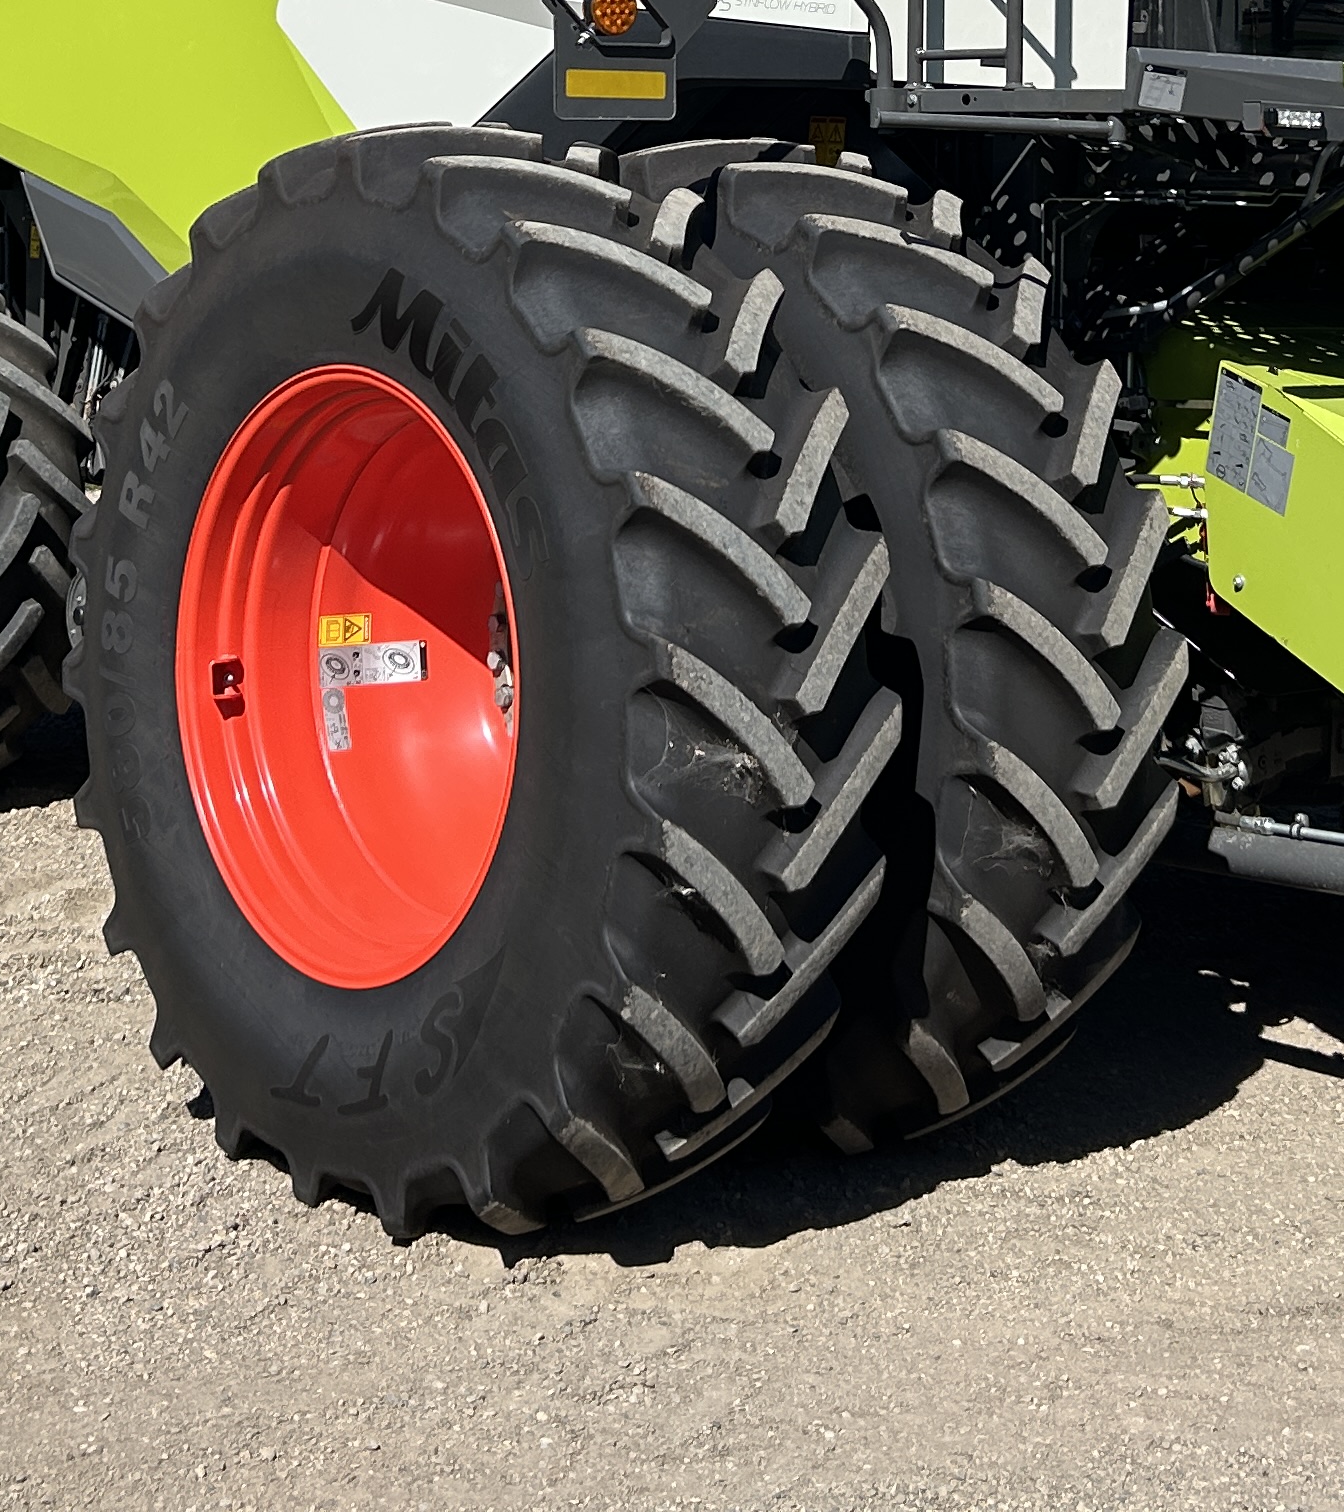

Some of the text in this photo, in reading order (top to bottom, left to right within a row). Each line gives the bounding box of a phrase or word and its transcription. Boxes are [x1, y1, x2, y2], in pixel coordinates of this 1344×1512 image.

[793, 0, 836, 15] HYBRID
[349, 266, 550, 582] Mitas
[269, 990, 465, 1117] SFT
